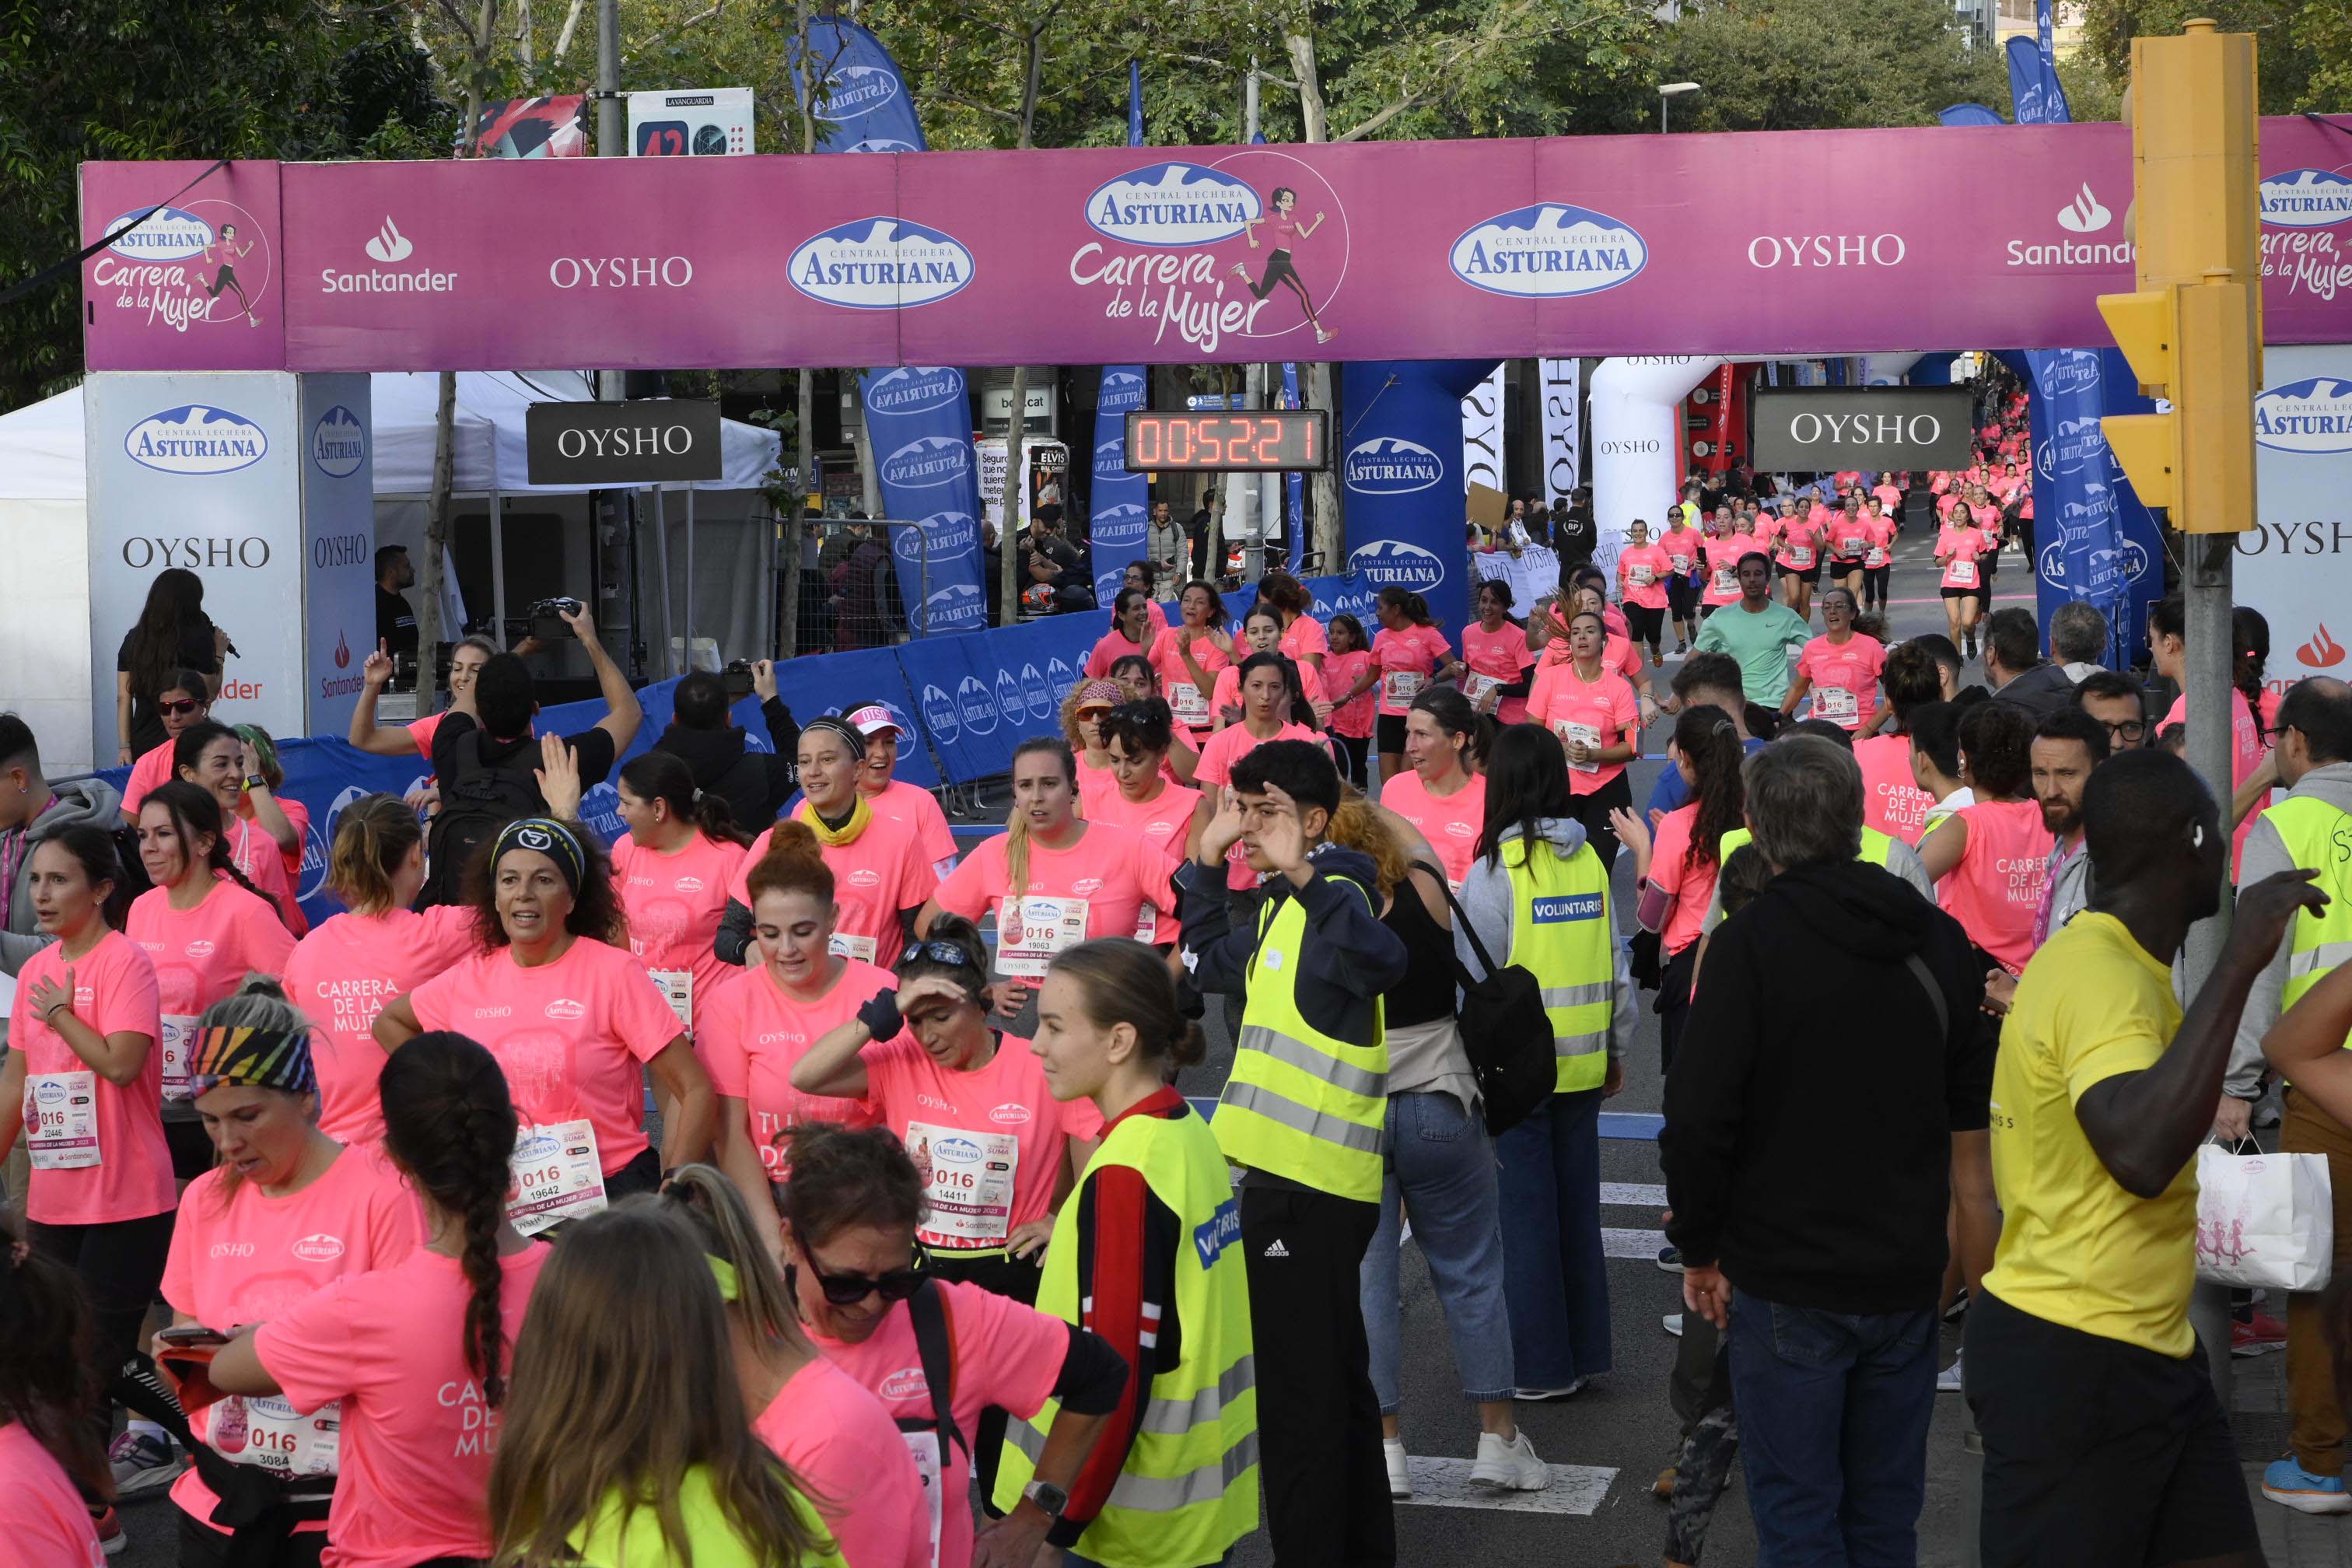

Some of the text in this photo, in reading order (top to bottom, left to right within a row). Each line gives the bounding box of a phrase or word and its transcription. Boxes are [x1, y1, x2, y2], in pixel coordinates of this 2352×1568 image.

[1125, 191, 1243, 200] CENTRAL LECHERA
[1098, 194, 1247, 226] ASTURIANA
[1496, 234, 1626, 246] CENTRAL LECHERA
[2260, 232, 2334, 254] arrera
[830, 247, 954, 259] CENTRAL LECHERA
[1464, 240, 1633, 275] ASTURIANA
[1748, 233, 1906, 268] OYSHO
[93, 257, 185, 287] Carrera
[550, 256, 693, 289] OYSHO
[802, 251, 960, 285] ASTURIANA
[1069, 243, 1216, 285] Carrera
[322, 268, 458, 293] Santander
[2278, 250, 2352, 301] la Muje
[117, 282, 220, 333] de la Mujer
[1105, 280, 1269, 353] de la Mujer
[1548, 359, 1574, 496] OYSH
[1790, 413, 1941, 446] OYSHO
[136, 431, 257, 457] ASTURIANA
[317, 432, 362, 460] ASTURIANA
[558, 425, 692, 458] OYSHO
[1138, 418, 1312, 463] 00:52:21
[1601, 439, 1660, 455] OYSHO
[1041, 453, 1065, 463] ELVIS
[1348, 460, 1436, 481] ASTURIANA
[2234, 521, 2352, 555] OYSH
[123, 537, 270, 568] OYSHO
[315, 534, 366, 569] OYSHO
[322, 674, 366, 698] Santander
[1888, 797, 1928, 813] DE LA
[1884, 810, 1923, 826] MUJE
[1996, 856, 2048, 873] CARRER
[2009, 872, 2047, 887] DE LA
[2007, 886, 2042, 902] MUJE
[1535, 899, 1601, 918] VOLUNTARIS
[1025, 926, 1055, 940] 016
[317, 978, 399, 999] CARRERA
[334, 996, 384, 1015] DE LA
[474, 1006, 513, 1020] OYSHO
[334, 1013, 377, 1034] MUJE
[758, 1031, 807, 1045] OYSHO
[41, 1111, 65, 1125] 016
[44, 1129, 63, 1138] 22446
[563, 1134, 586, 1143] SUMA
[936, 1146, 978, 1160] ASTURIANA
[523, 1166, 561, 1188] 016
[936, 1169, 975, 1188] 016
[530, 1185, 560, 1200] 19642
[555, 1195, 577, 1206] MUJER
[939, 1189, 967, 1202] 14411
[959, 1206, 982, 1215] MUJER
[514, 1214, 545, 1232] OYSHO
[965, 1221, 999, 1230] Santander
[210, 1243, 254, 1258] OSHO
[251, 1428, 298, 1454] 016
[259, 1454, 290, 1467] 3084
